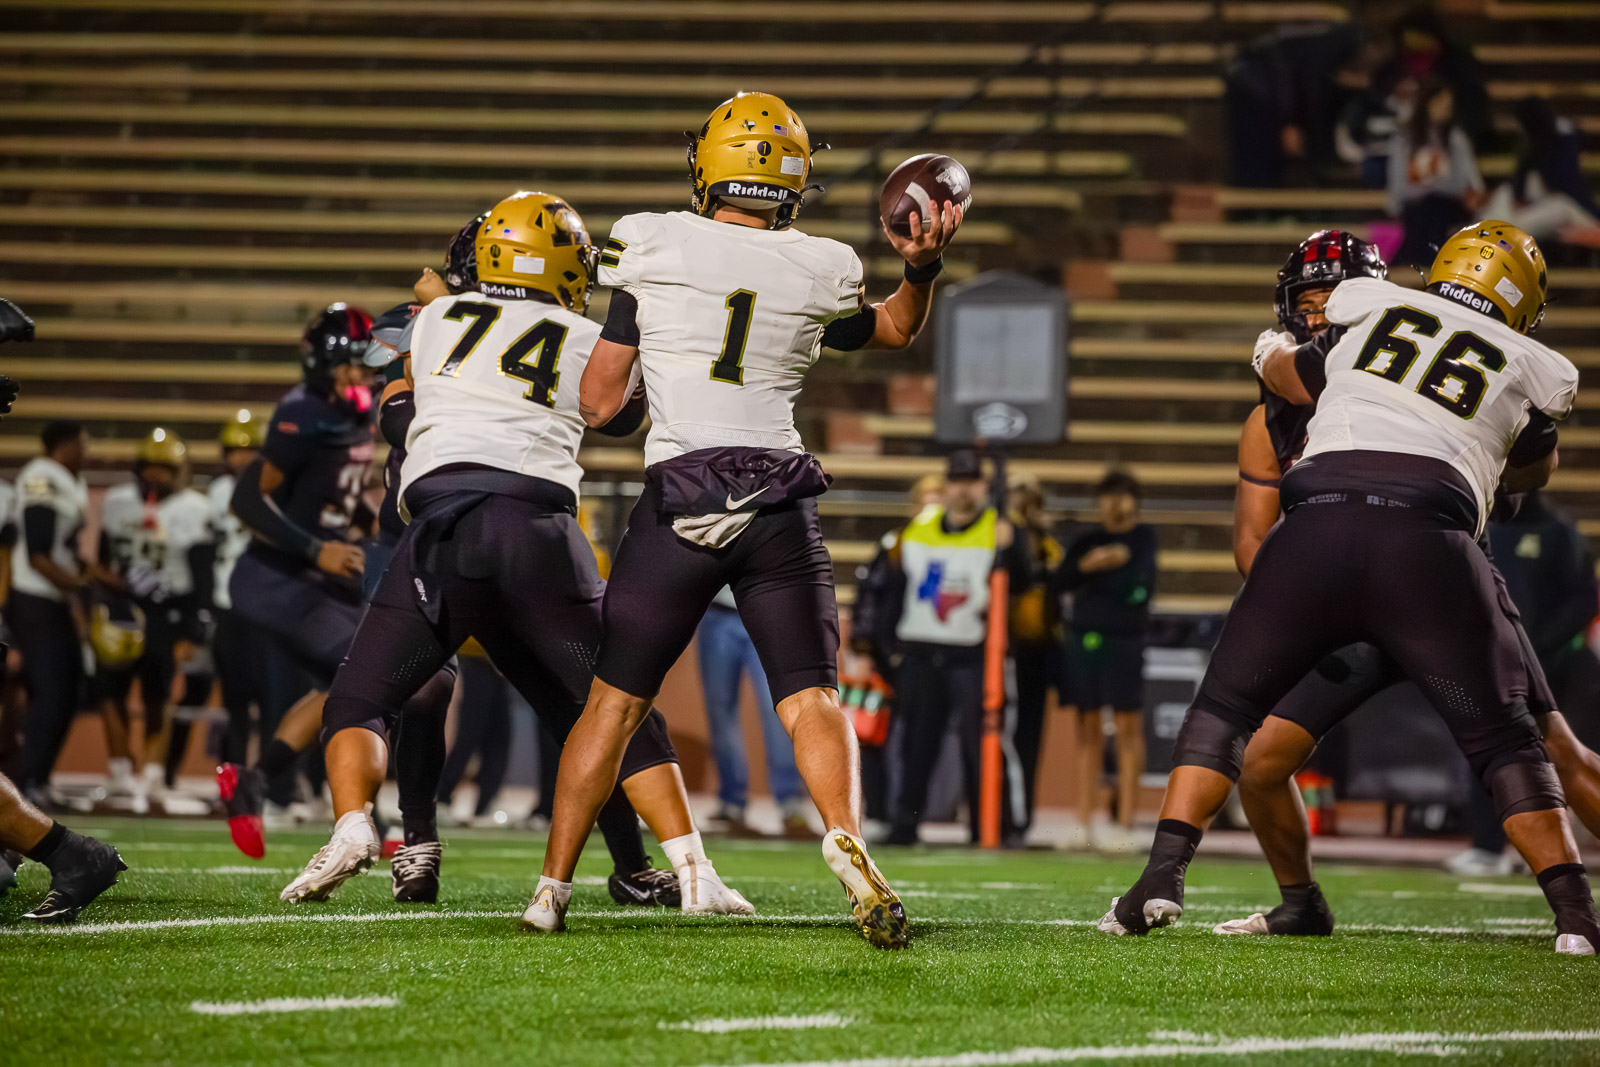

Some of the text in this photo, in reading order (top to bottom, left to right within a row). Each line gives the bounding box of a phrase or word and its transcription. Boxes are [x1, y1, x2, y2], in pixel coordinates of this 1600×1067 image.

[728, 182, 788, 201] Riddell
[480, 283, 527, 298] Riddell
[1439, 283, 1493, 314] Riddell
[431, 301, 569, 409] 74
[709, 288, 757, 386] 1
[1352, 304, 1507, 420] 66
